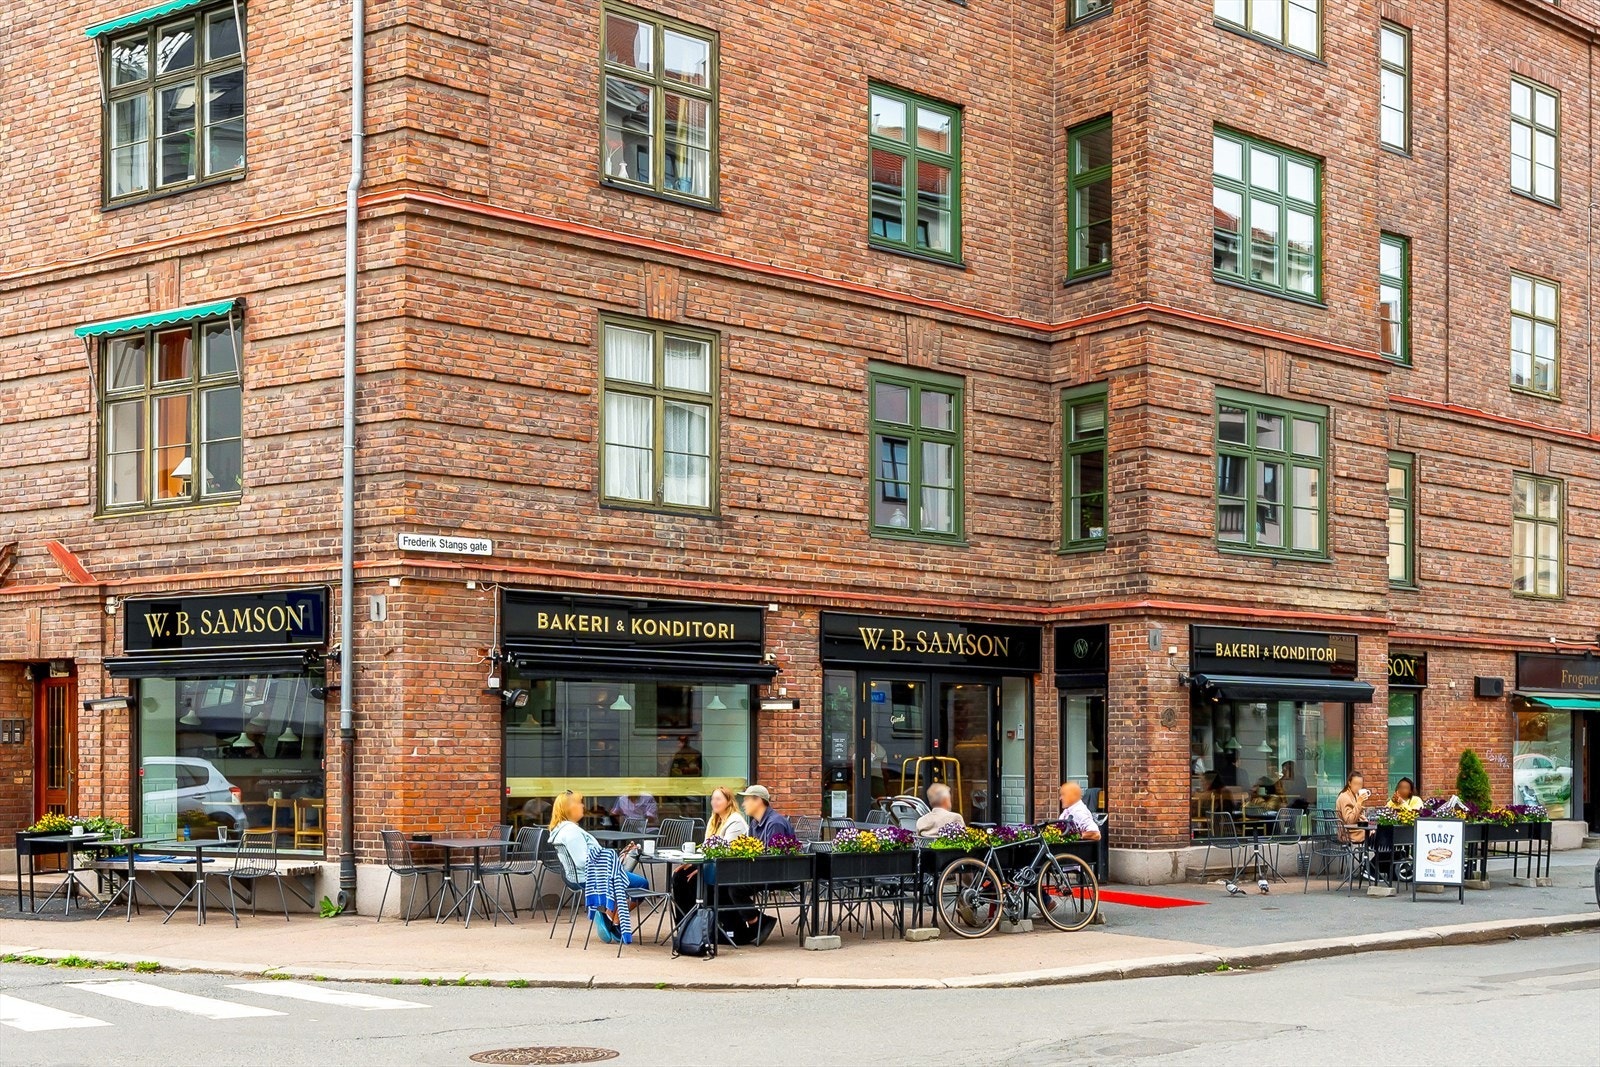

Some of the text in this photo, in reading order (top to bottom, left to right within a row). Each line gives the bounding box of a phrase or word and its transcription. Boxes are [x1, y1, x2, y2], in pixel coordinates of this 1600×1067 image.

[403, 536, 488, 552] Frederik Stangs gate
[143, 604, 305, 638] W. B. SAMSON
[537, 612, 735, 640] BAKERI & KONDITORI
[858, 627, 1010, 657] W. B. SAMSON
[1215, 642, 1337, 661] BAKERI & KONDITORI
[1561, 669, 1599, 689] Frogner
[1424, 832, 1455, 845] TOAST
